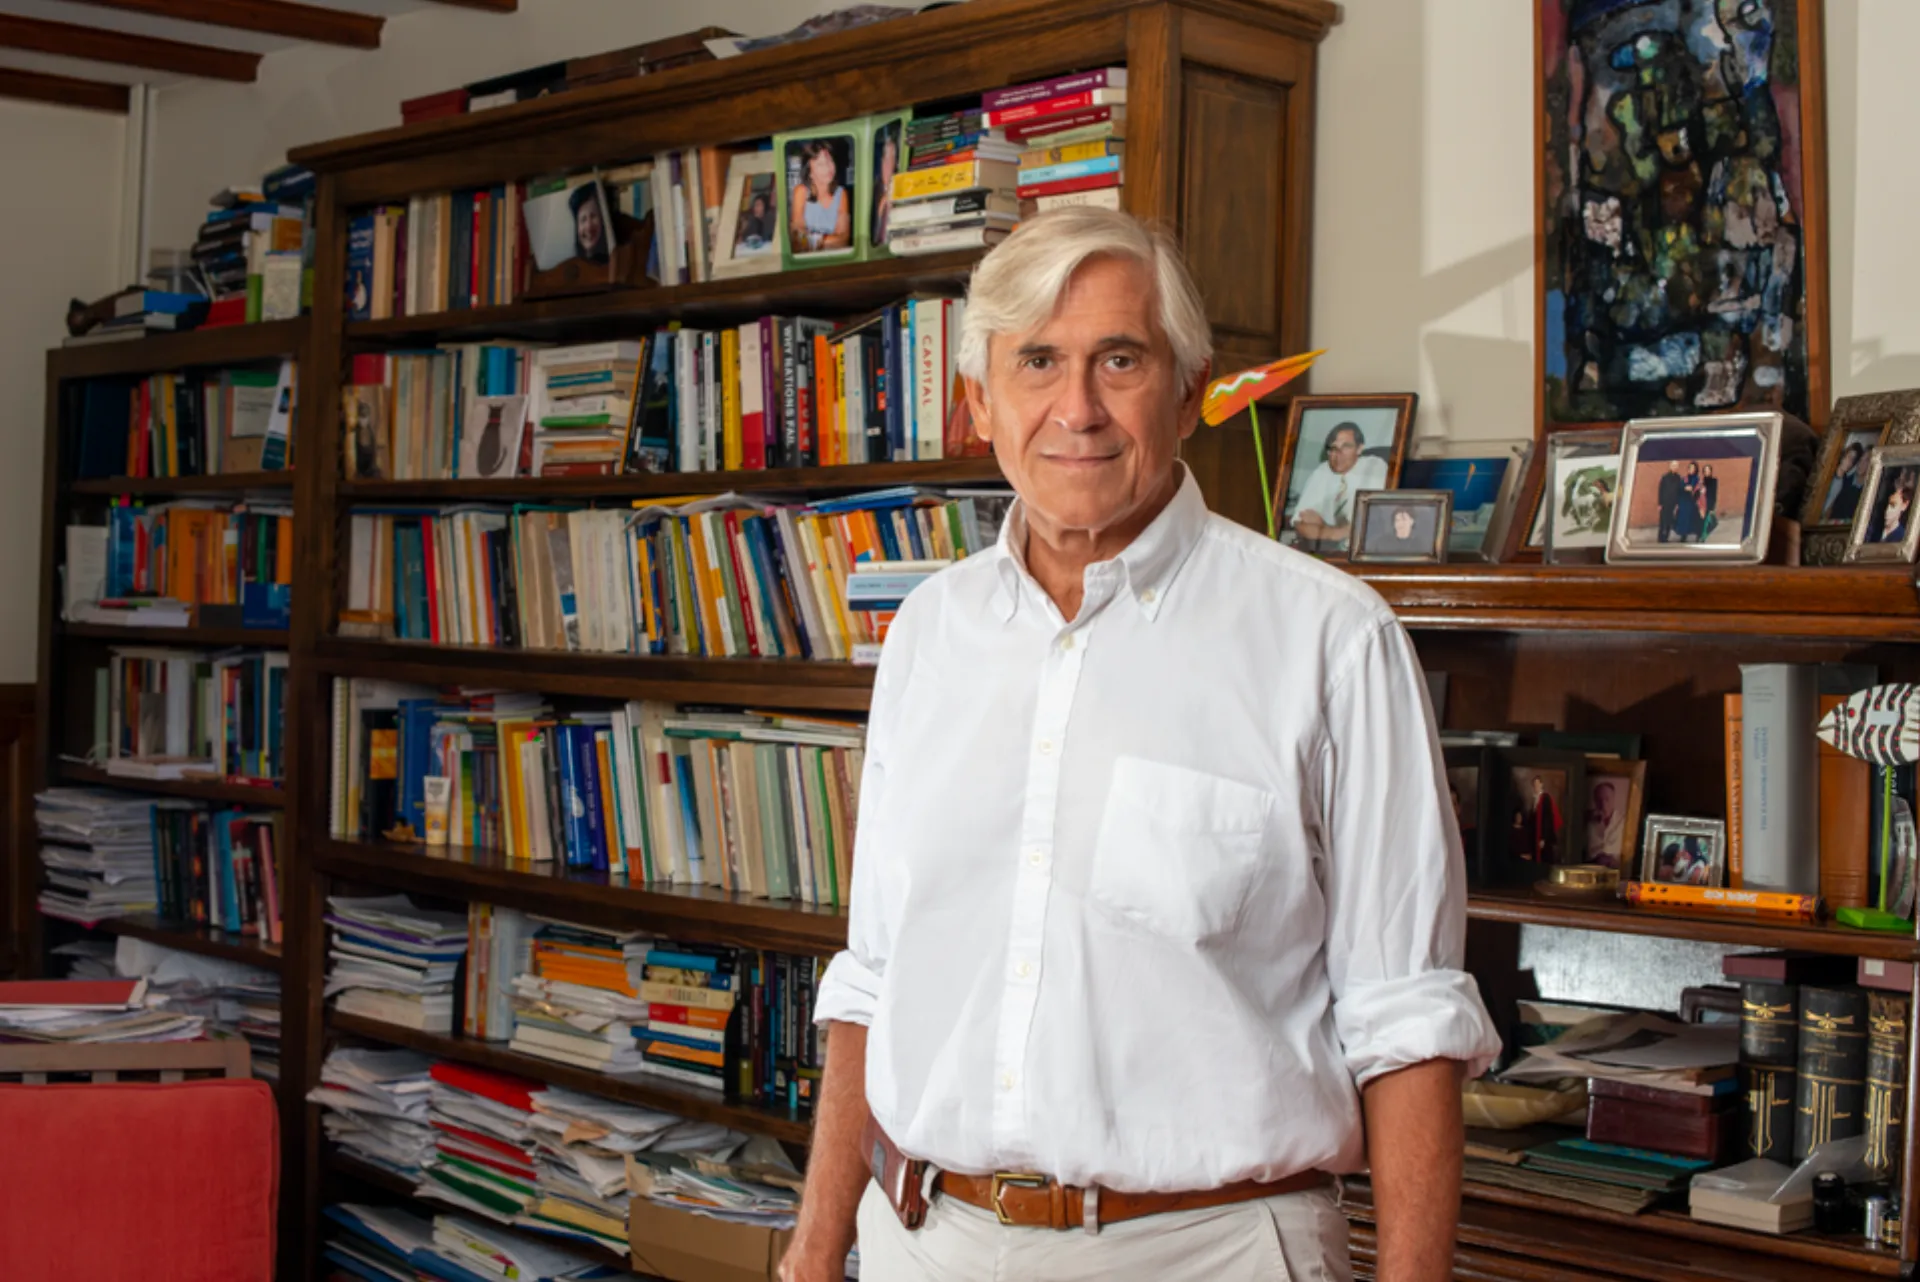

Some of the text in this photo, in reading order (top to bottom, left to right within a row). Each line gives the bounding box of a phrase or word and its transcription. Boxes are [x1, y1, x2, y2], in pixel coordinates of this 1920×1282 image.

[783, 324, 796, 449] WHY NATIONS FAIL
[922, 334, 933, 408] CAPITAL
